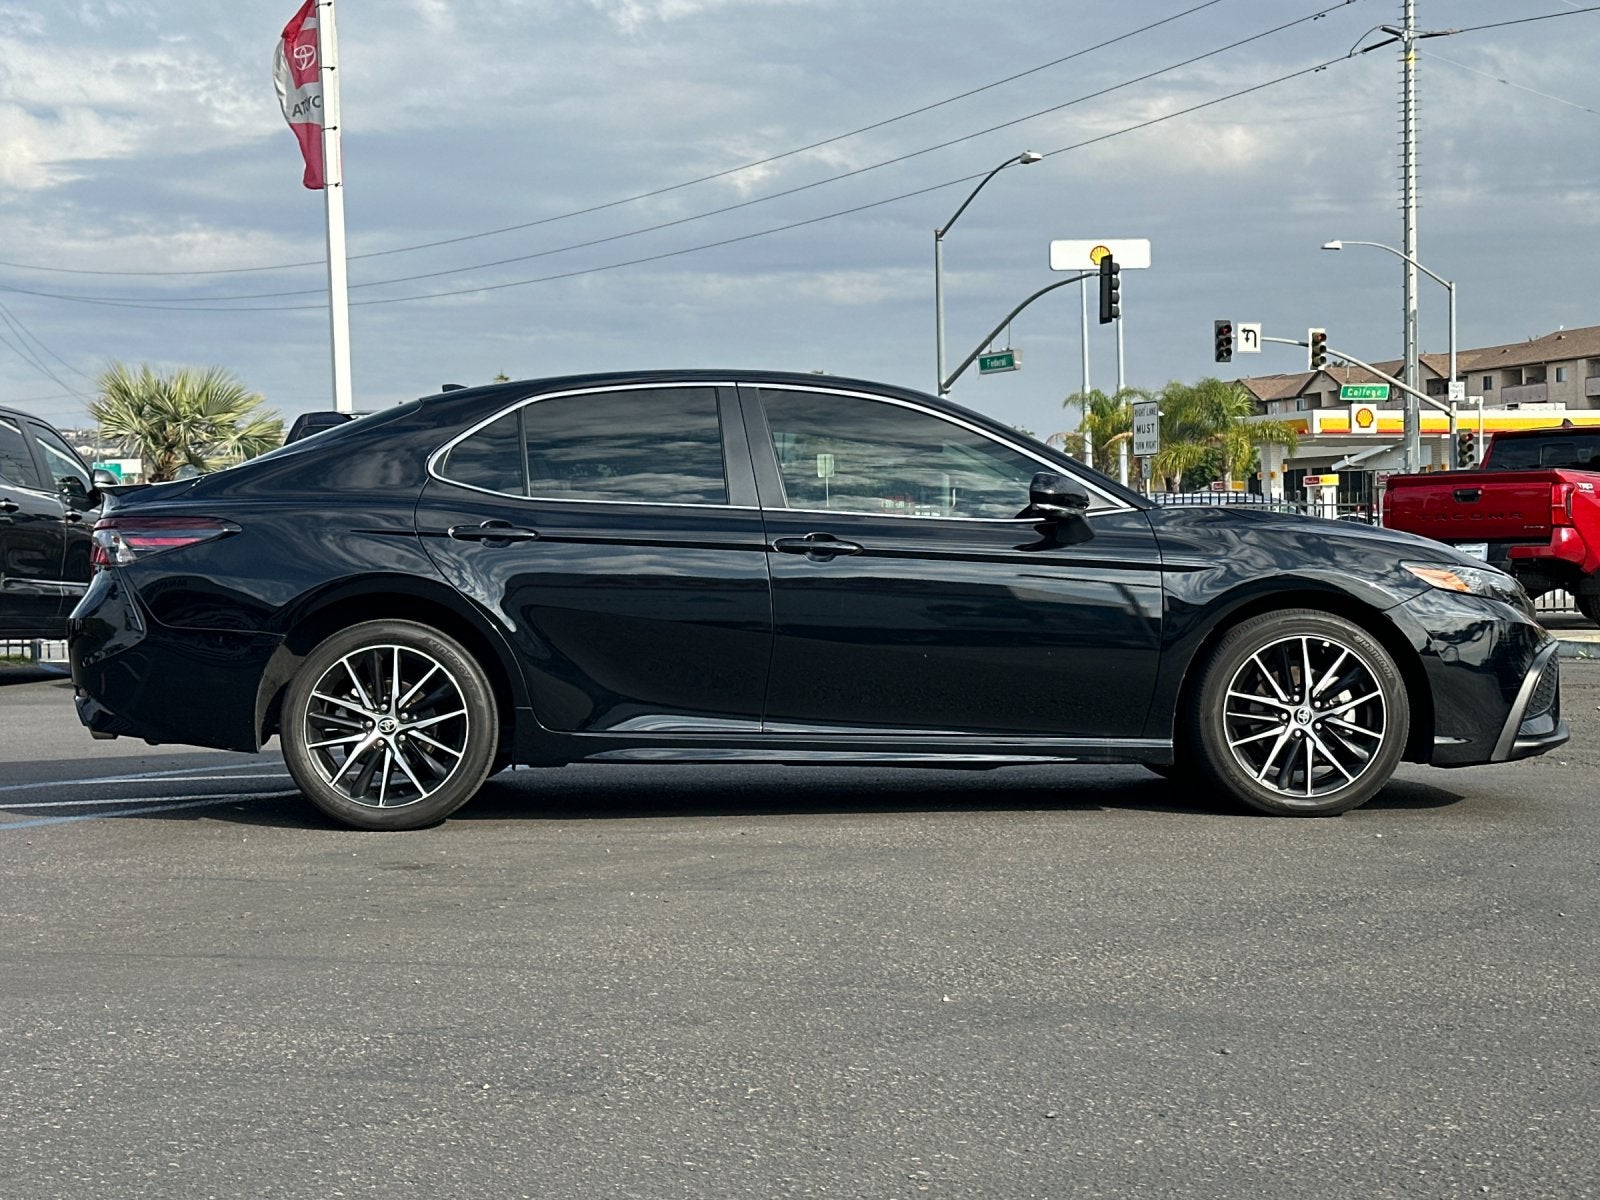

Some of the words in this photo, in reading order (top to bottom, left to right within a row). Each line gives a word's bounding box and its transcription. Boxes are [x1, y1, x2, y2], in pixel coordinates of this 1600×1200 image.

[1347, 388, 1382, 398] College
[1136, 423, 1155, 434] MUST
[1415, 512, 1523, 521] TACOMA
